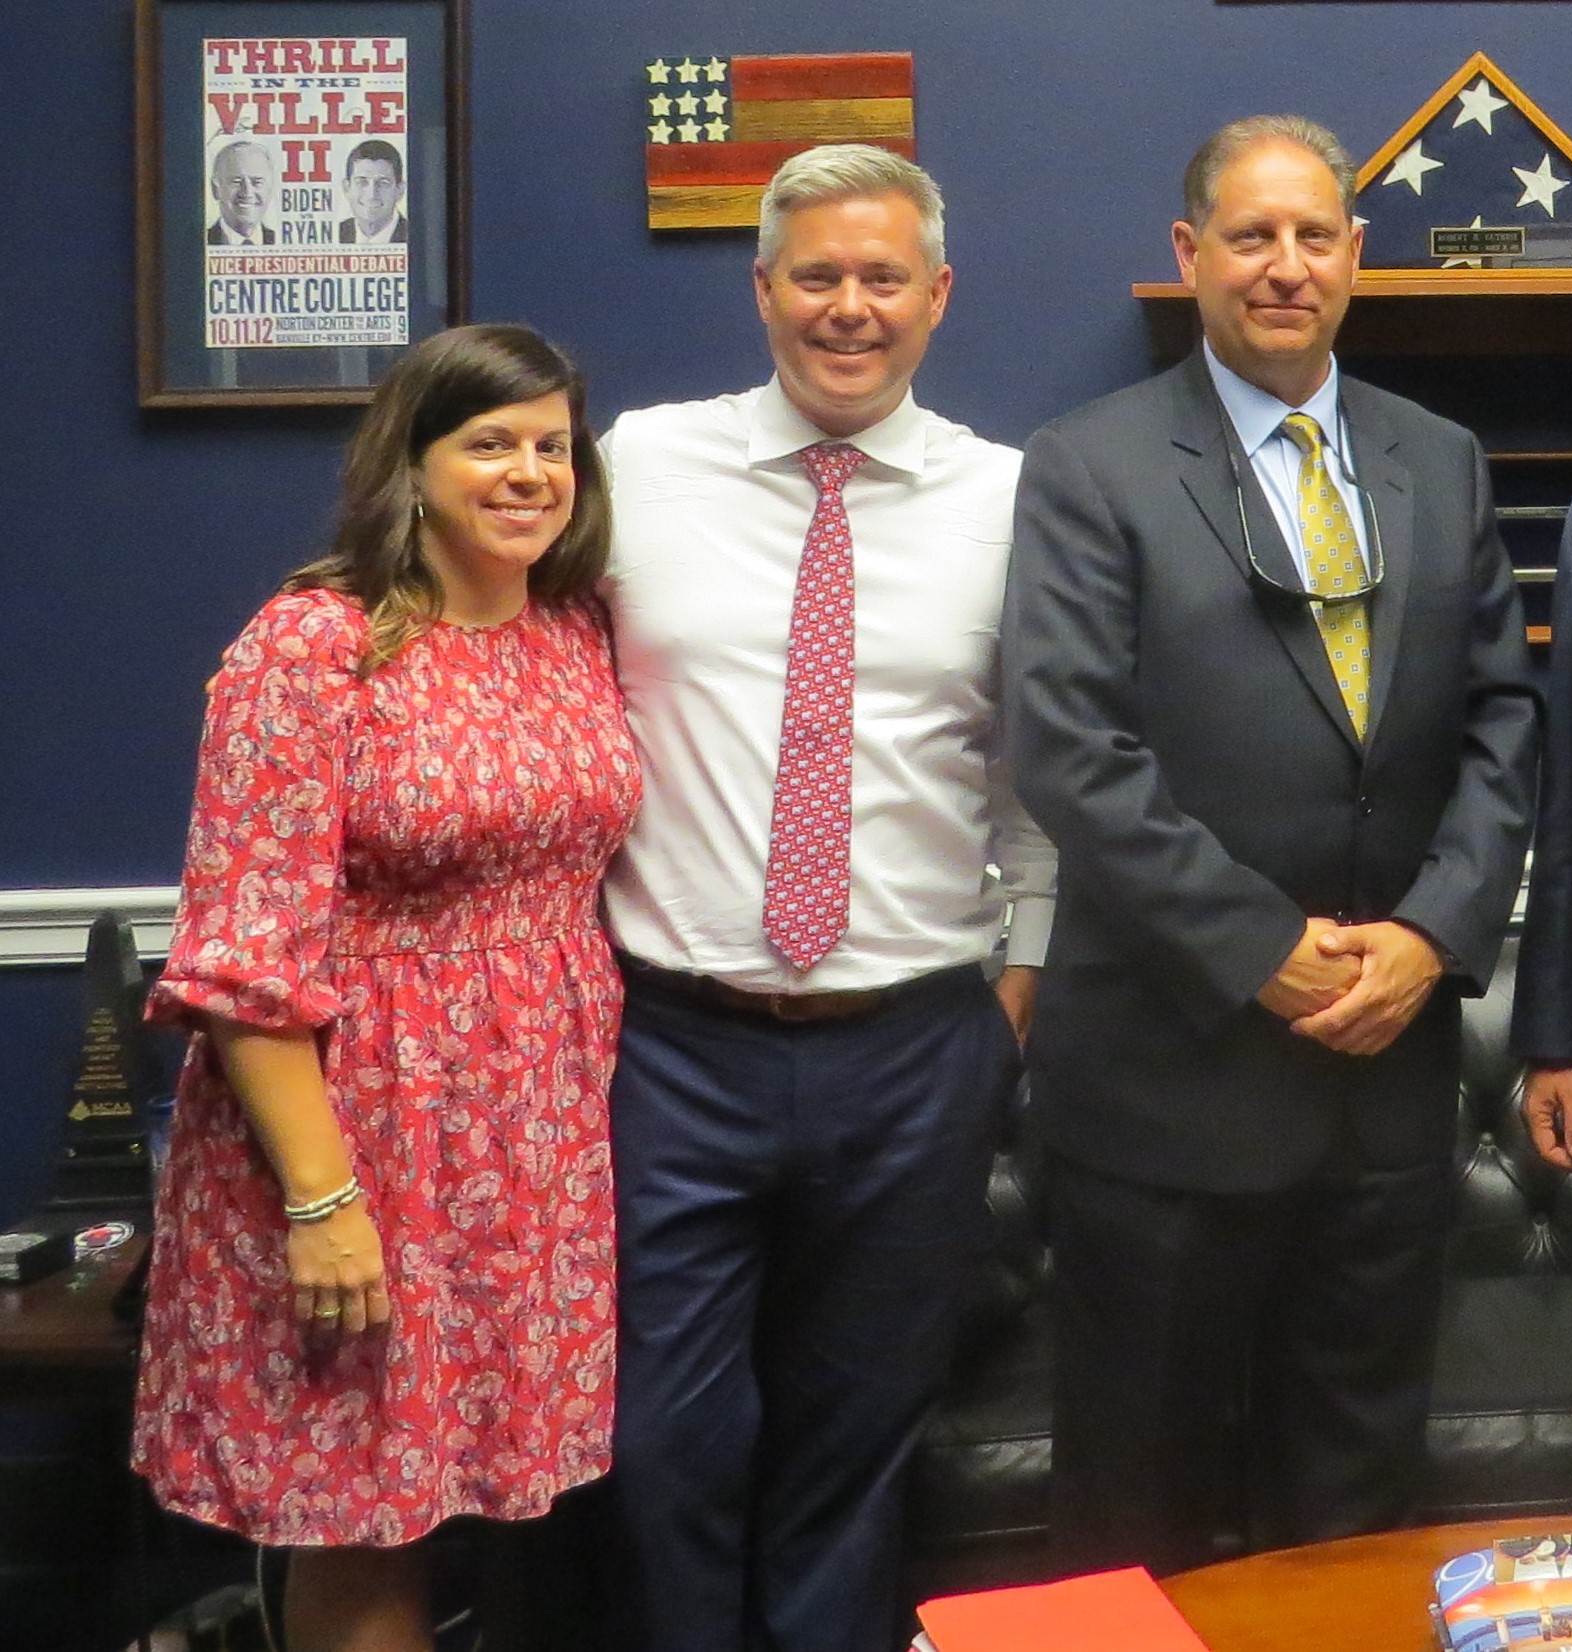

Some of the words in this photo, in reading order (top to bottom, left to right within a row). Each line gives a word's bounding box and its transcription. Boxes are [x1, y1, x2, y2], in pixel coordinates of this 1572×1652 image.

[207, 40, 404, 74] THRILL
[250, 78, 286, 88] IN
[295, 77, 361, 88] THE
[208, 92, 405, 135] VILLE
[281, 140, 332, 182] II
[281, 188, 333, 212] BIDEN
[281, 221, 333, 245] RYAN
[209, 256, 245, 274] VICE
[246, 256, 347, 274] PRESIDENTIAL
[350, 255, 405, 273] DEBATE
[209, 278, 301, 314] CENTRE
[304, 277, 406, 313] COLLEGE
[209, 317, 274, 345] 10.11.12
[317, 316, 355, 331] CENTER
[365, 315, 392, 330] ARTS
[397, 315, 406, 334] 9
